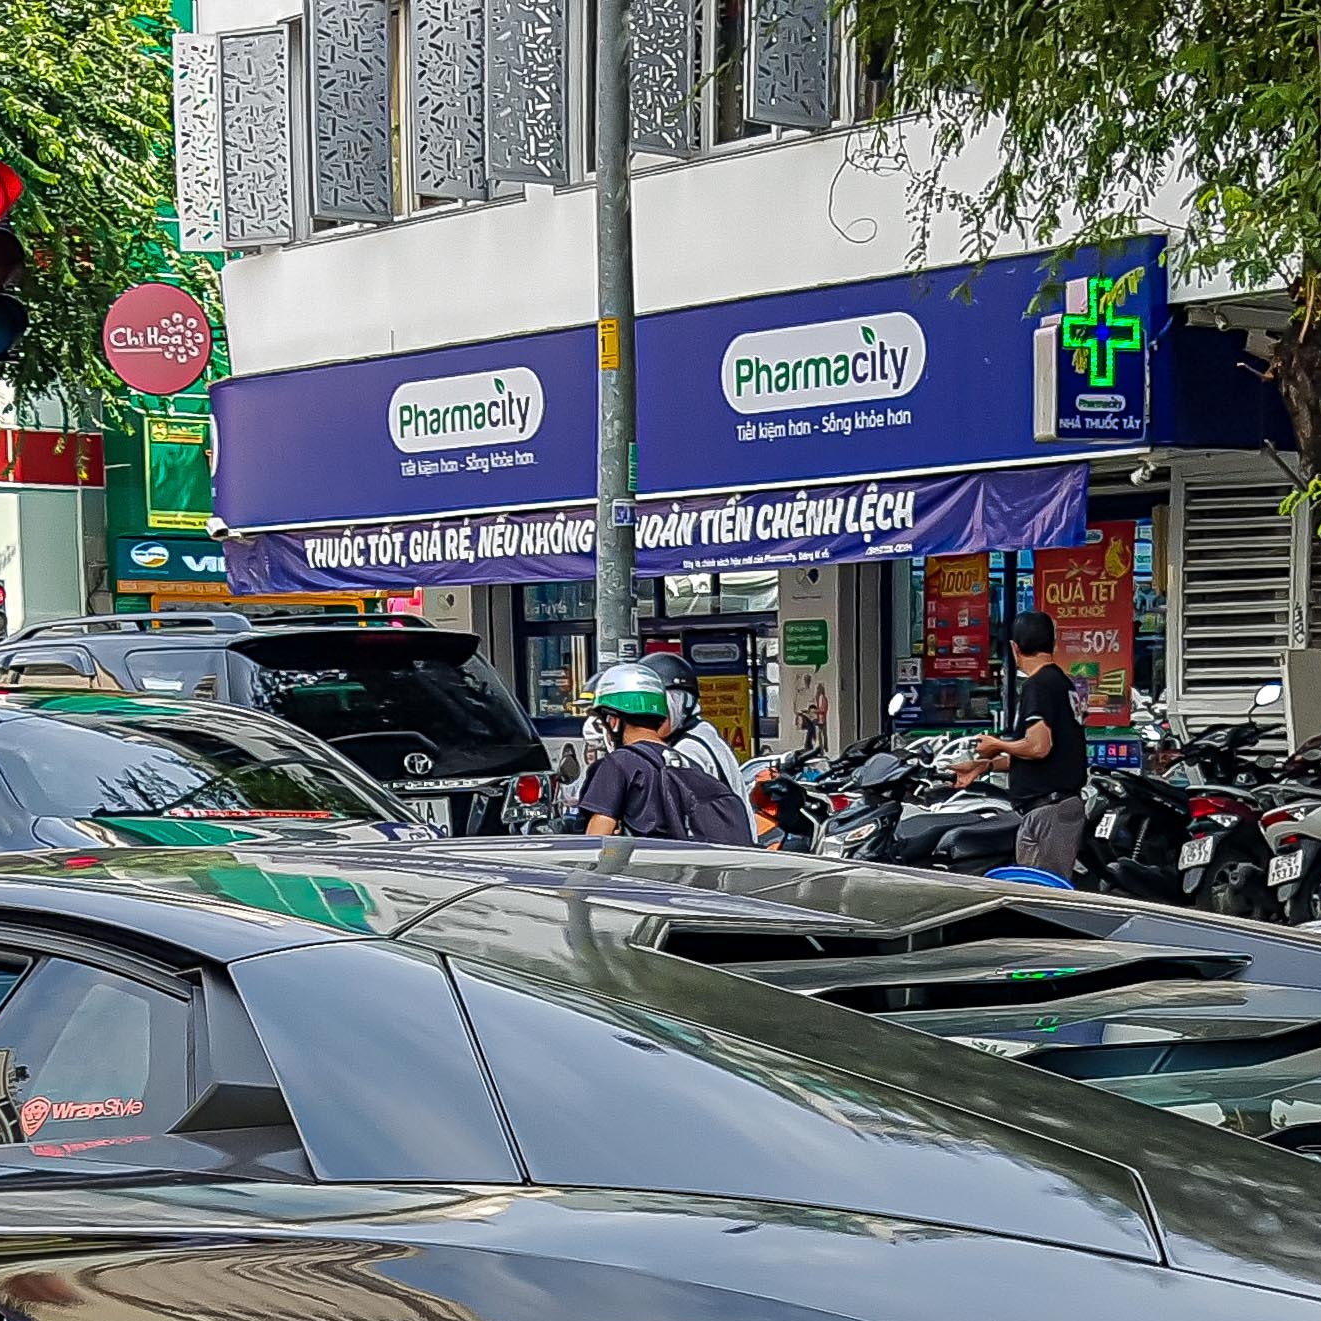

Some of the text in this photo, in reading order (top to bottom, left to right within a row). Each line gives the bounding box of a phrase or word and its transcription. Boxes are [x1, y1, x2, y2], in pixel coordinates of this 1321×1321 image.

[735, 326, 909, 397] Pharmacity
[400, 379, 530, 438] Pharmacity
[788, 419, 812, 437] hơn
[822, 412, 852, 435] Sống
[887, 408, 912, 426] hơn
[304, 525, 365, 569] THUỐC
[367, 524, 407, 568] TỐT,
[409, 520, 443, 563] GIÁ
[478, 512, 519, 559] NẾU
[520, 511, 596, 555] KHÔNG
[700, 493, 753, 546] TIỀN
[756, 489, 845, 541] CHÊNH
[845, 482, 916, 543] LỆCH
[1081, 629, 1120, 654] 50%
[52, 1098, 145, 1120] WrapStyle
